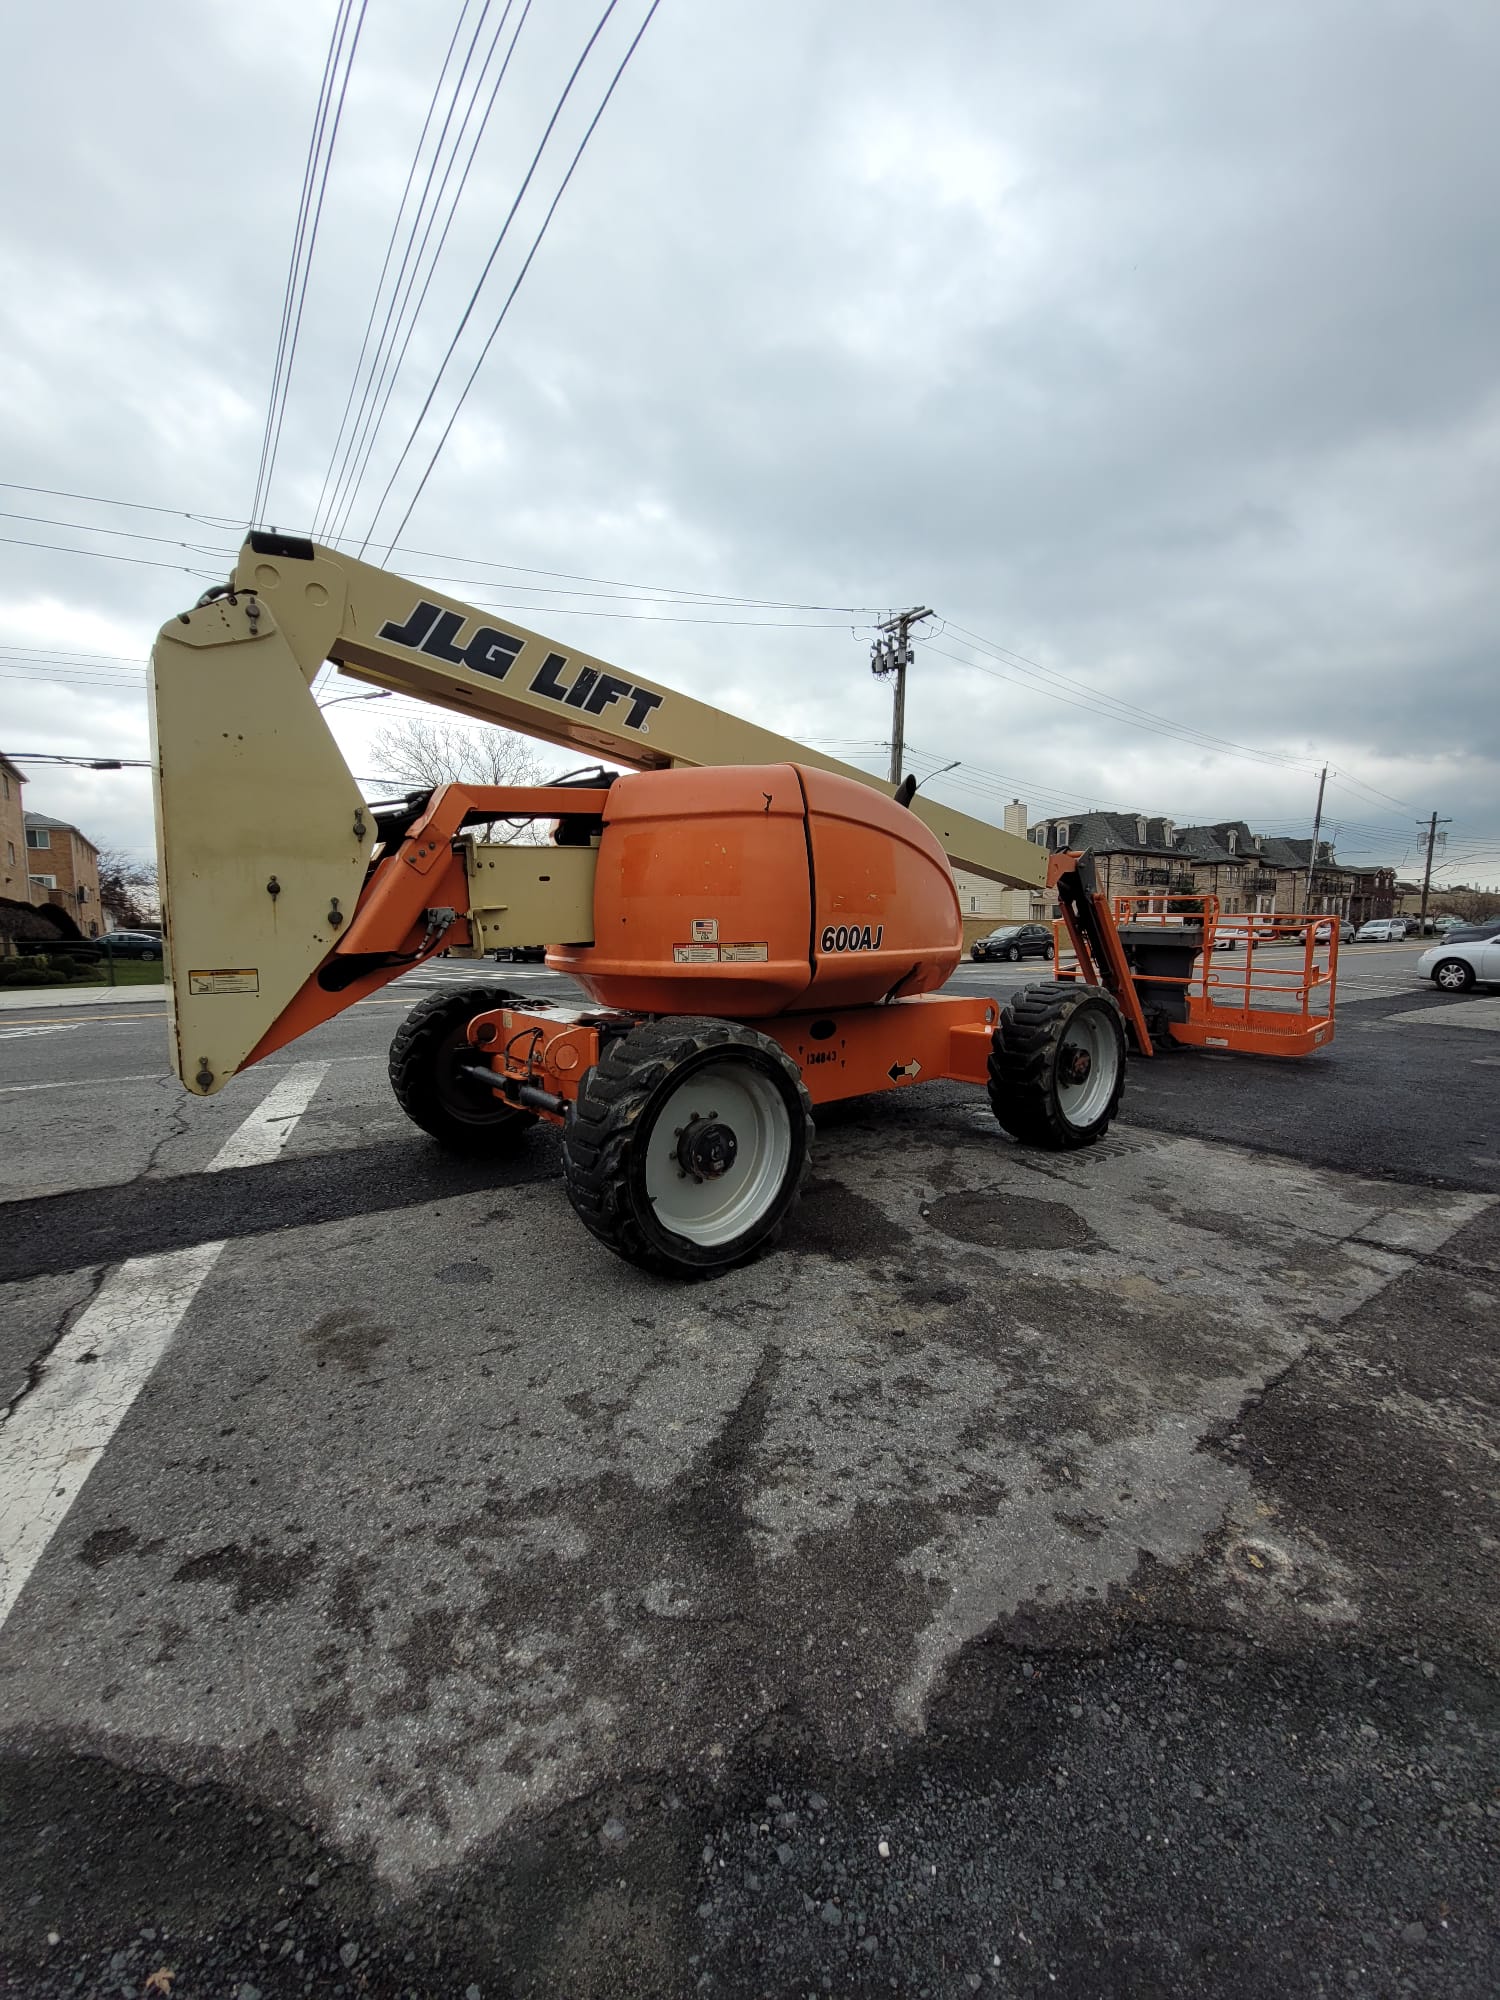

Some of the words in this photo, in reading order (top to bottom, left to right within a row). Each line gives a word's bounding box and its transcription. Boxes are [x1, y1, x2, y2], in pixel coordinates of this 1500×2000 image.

[375, 600, 528, 682] JLG
[527, 651, 666, 730] LIFT
[821, 925, 884, 953] 600AJ
